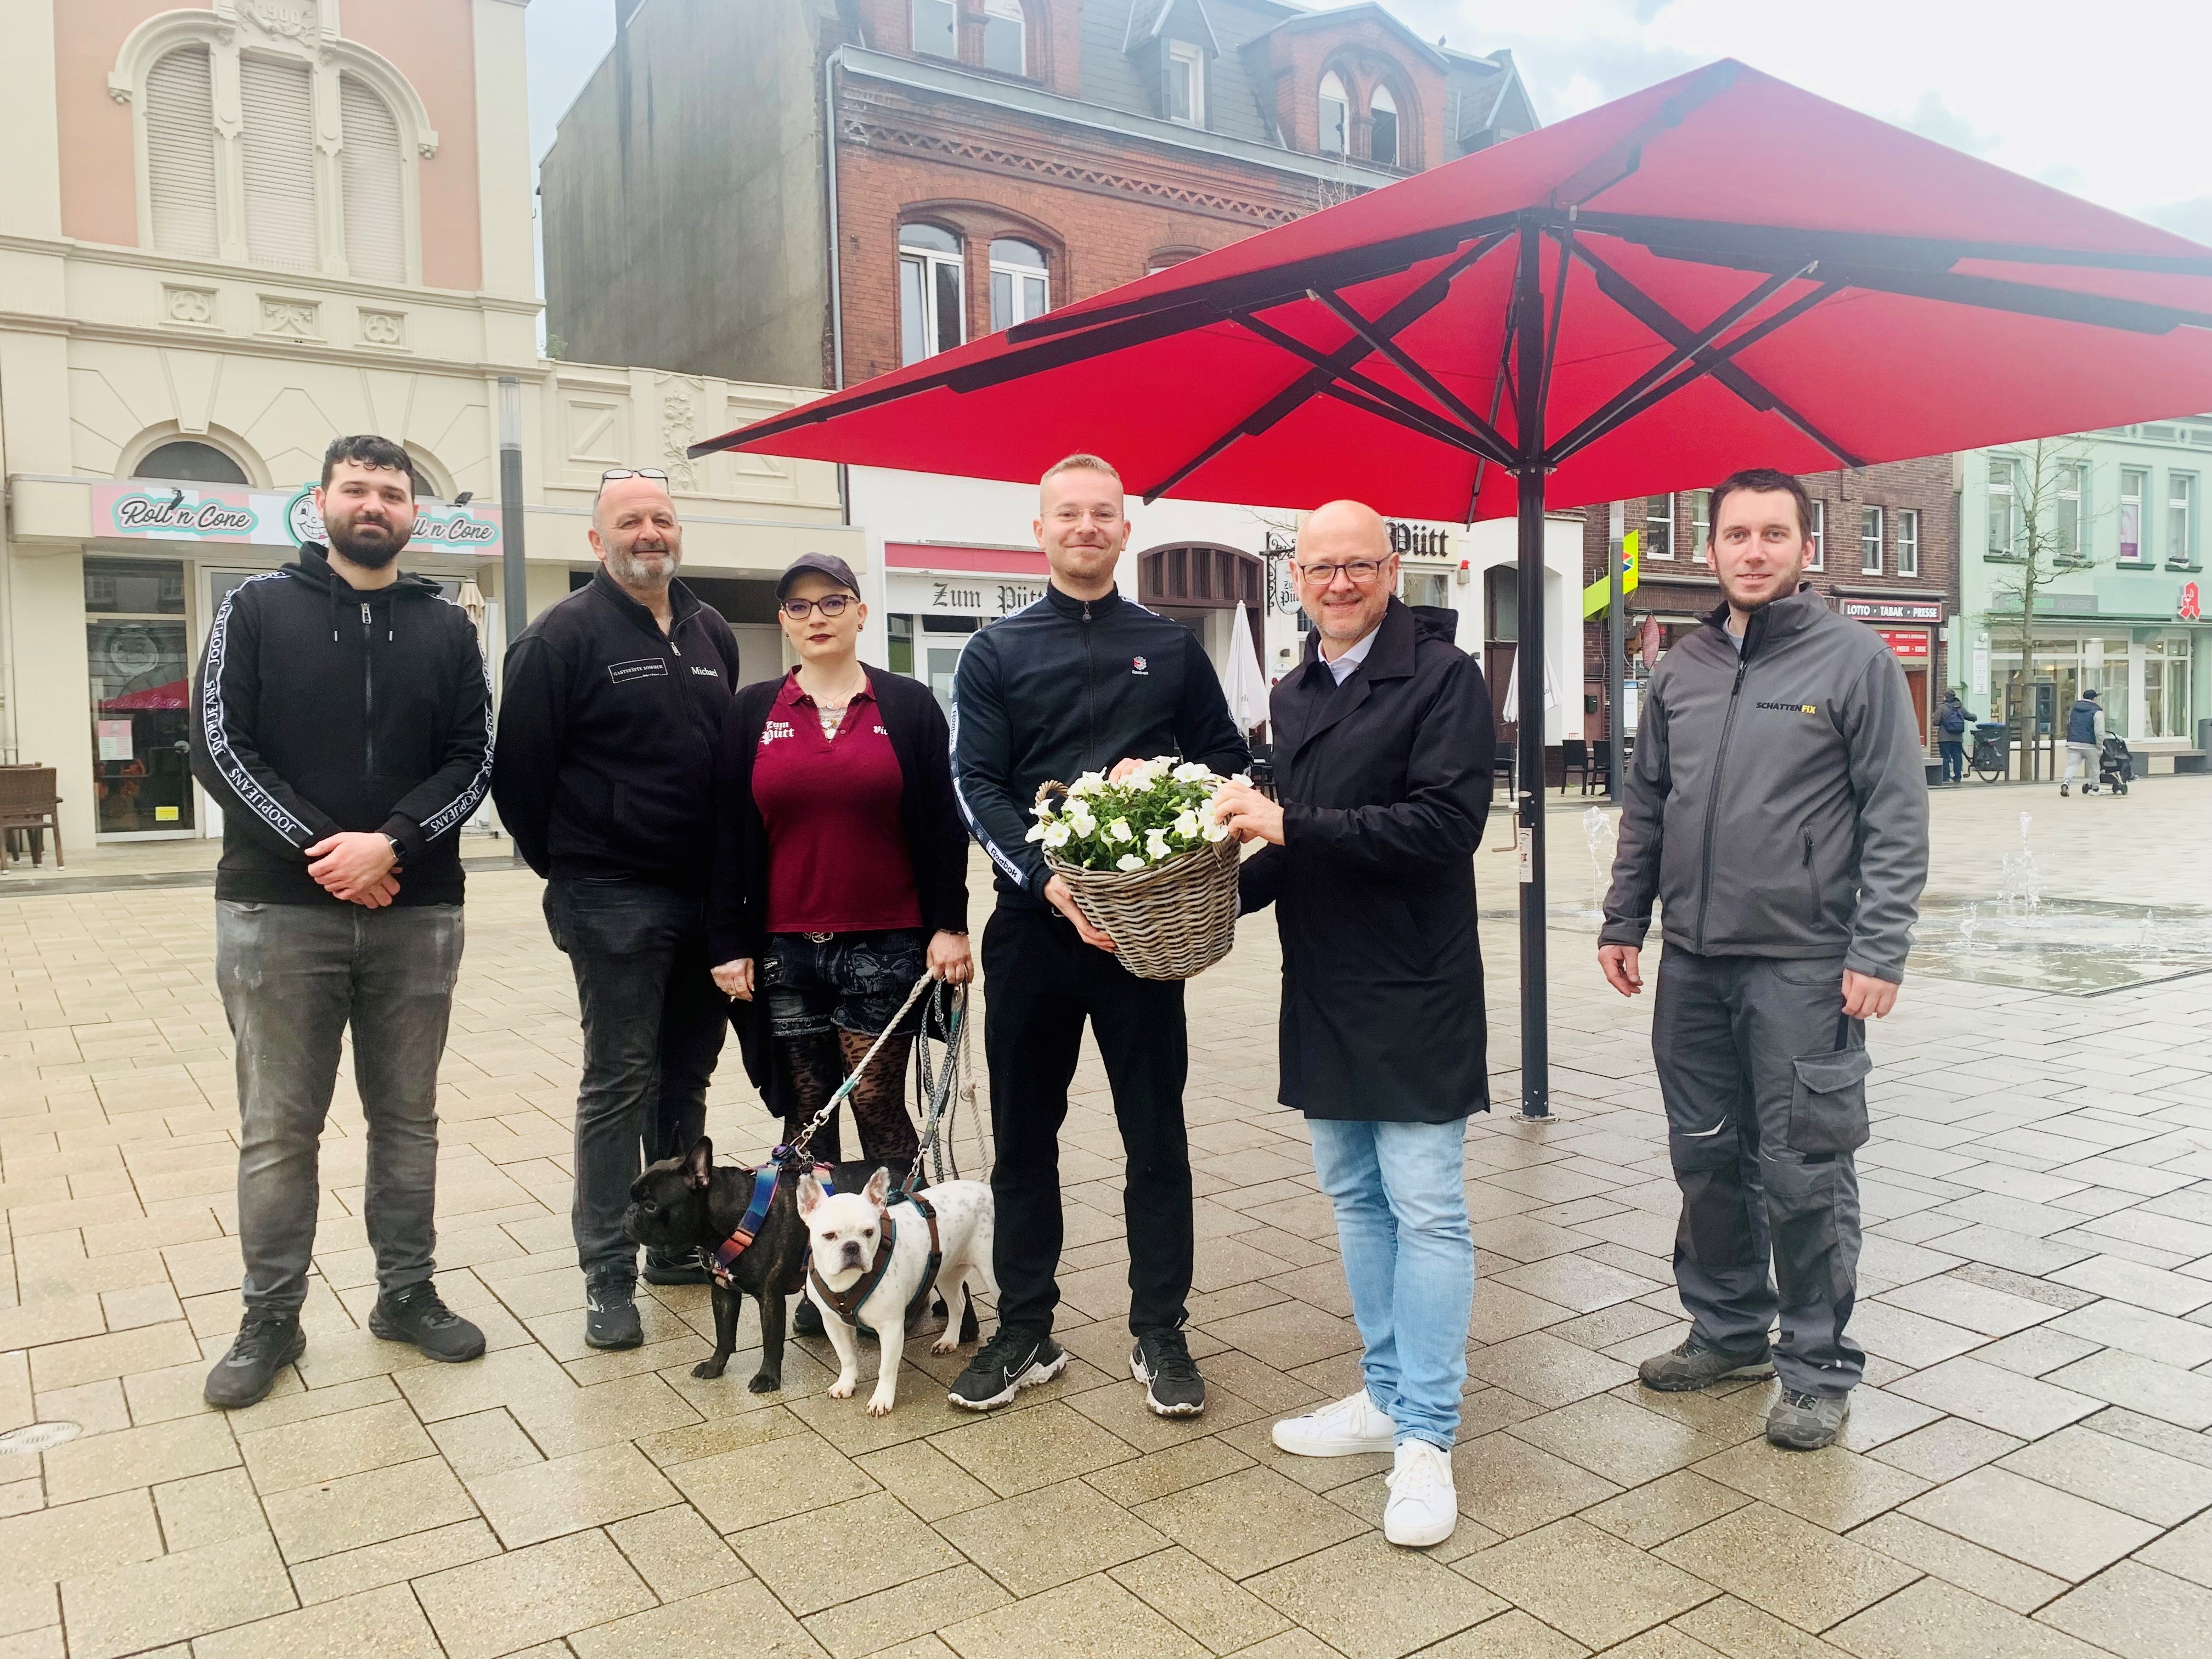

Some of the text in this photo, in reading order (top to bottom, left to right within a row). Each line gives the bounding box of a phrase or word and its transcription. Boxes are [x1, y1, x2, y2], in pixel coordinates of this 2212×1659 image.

[121, 500, 173, 524] Roll
[197, 506, 250, 528] Cone
[413, 519, 428, 535] ll
[448, 519, 493, 539] Cone
[1386, 522, 1449, 557] Pütt
[1284, 580, 1293, 590] Zu
[933, 582, 981, 608] Zum
[1280, 589, 1299, 606] Pü
[1847, 605, 1937, 618] LOTTO TABAK PRESSE
[691, 666, 719, 678] Michael
[1756, 702, 1816, 714] SCHATTENFIX
[205, 680, 226, 756] JOOP!JEANS
[765, 720, 789, 730] Zum
[760, 727, 794, 745] Pütt
[228, 768, 297, 833] JOOP!JEANS
[991, 848, 1018, 878] Reebok
